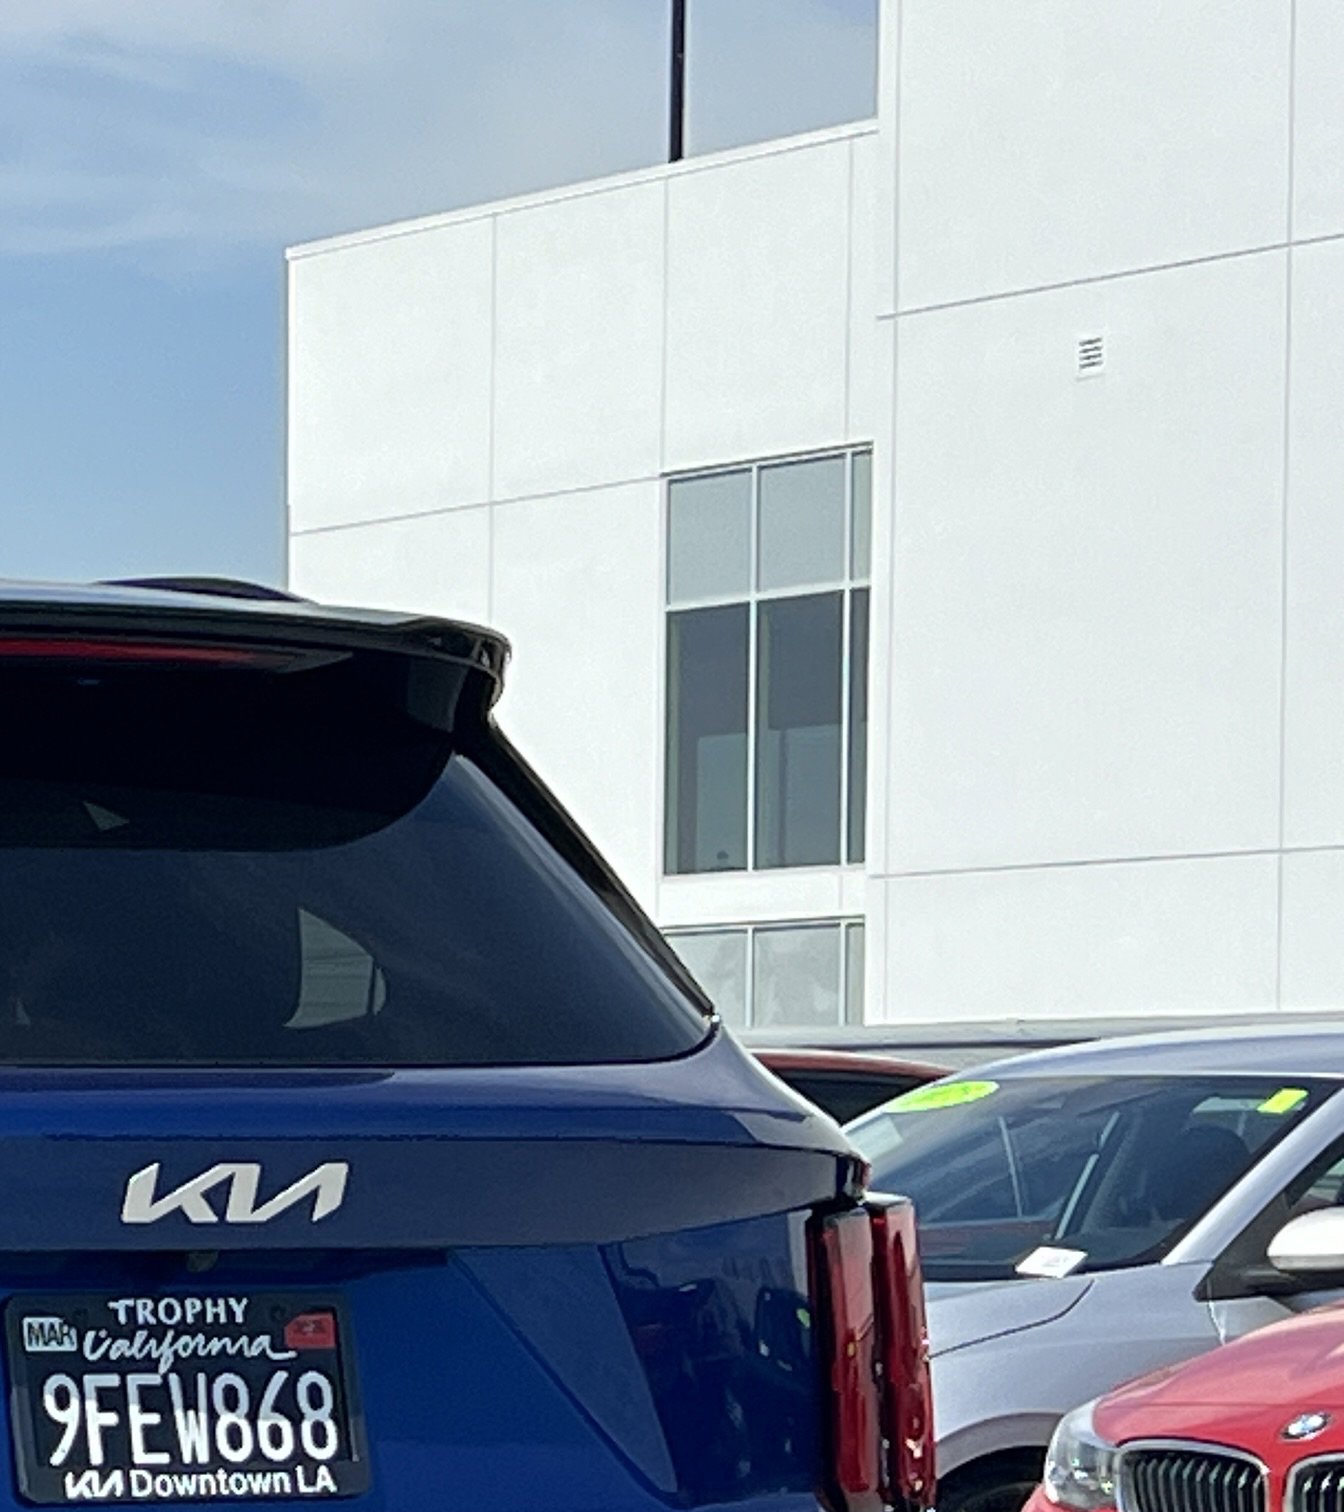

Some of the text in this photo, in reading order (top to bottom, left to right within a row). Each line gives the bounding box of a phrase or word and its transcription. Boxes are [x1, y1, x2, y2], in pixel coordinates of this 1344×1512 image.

[121, 1162, 349, 1224] KIA
[108, 1298, 248, 1326] TROPHY
[27, 1321, 75, 1347] MAR
[82, 1328, 298, 1375] California
[42, 1370, 339, 1467] 9FEW868
[64, 1464, 338, 1499] KIA Downtown LA
